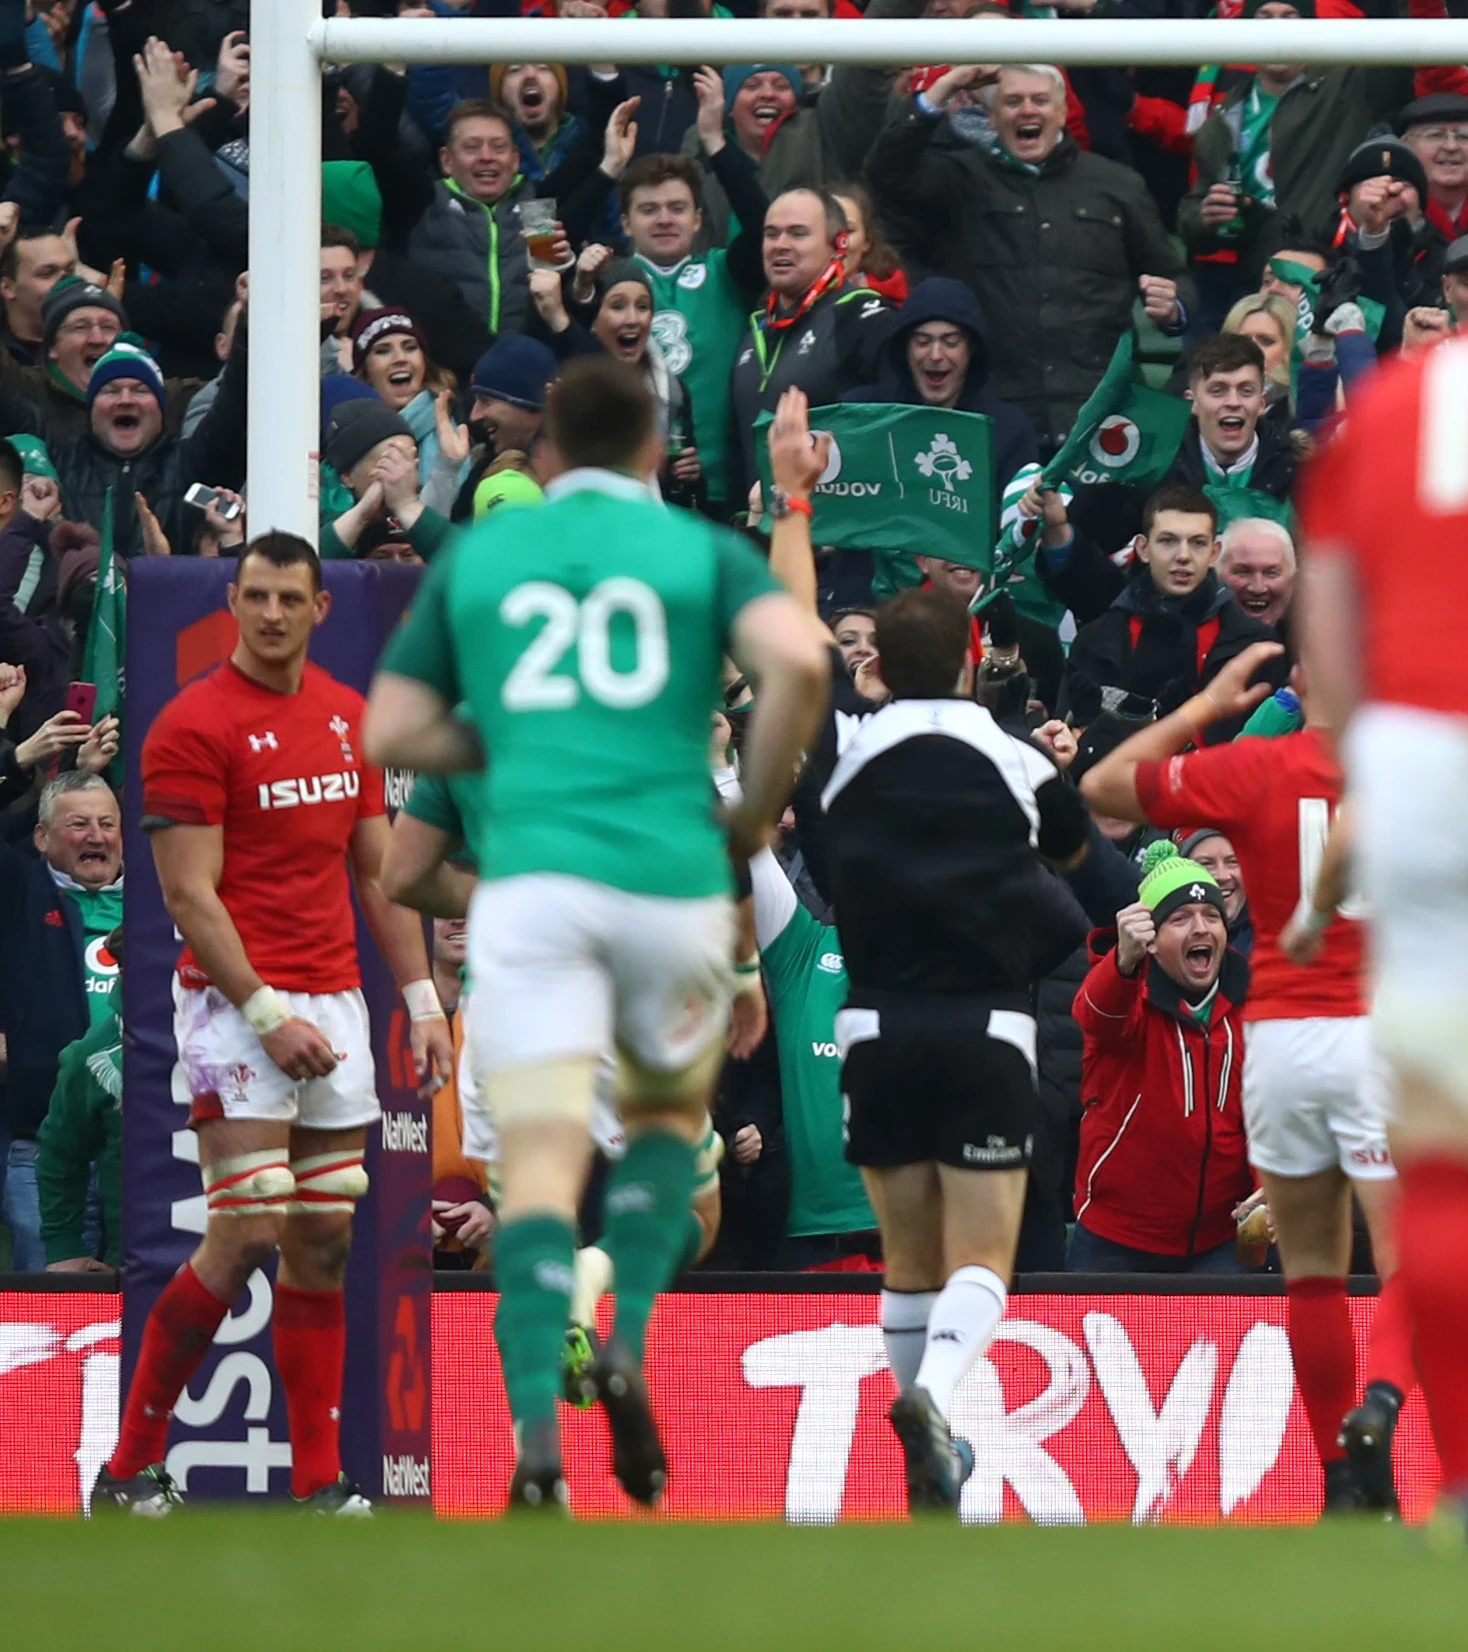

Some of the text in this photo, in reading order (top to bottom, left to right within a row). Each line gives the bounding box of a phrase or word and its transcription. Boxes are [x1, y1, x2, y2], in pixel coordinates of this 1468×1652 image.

[500, 576, 670, 713] 20
[257, 770, 360, 811] ISUZU
[382, 1110, 428, 1154] NatWest
[383, 1454, 430, 1496] NatWest
